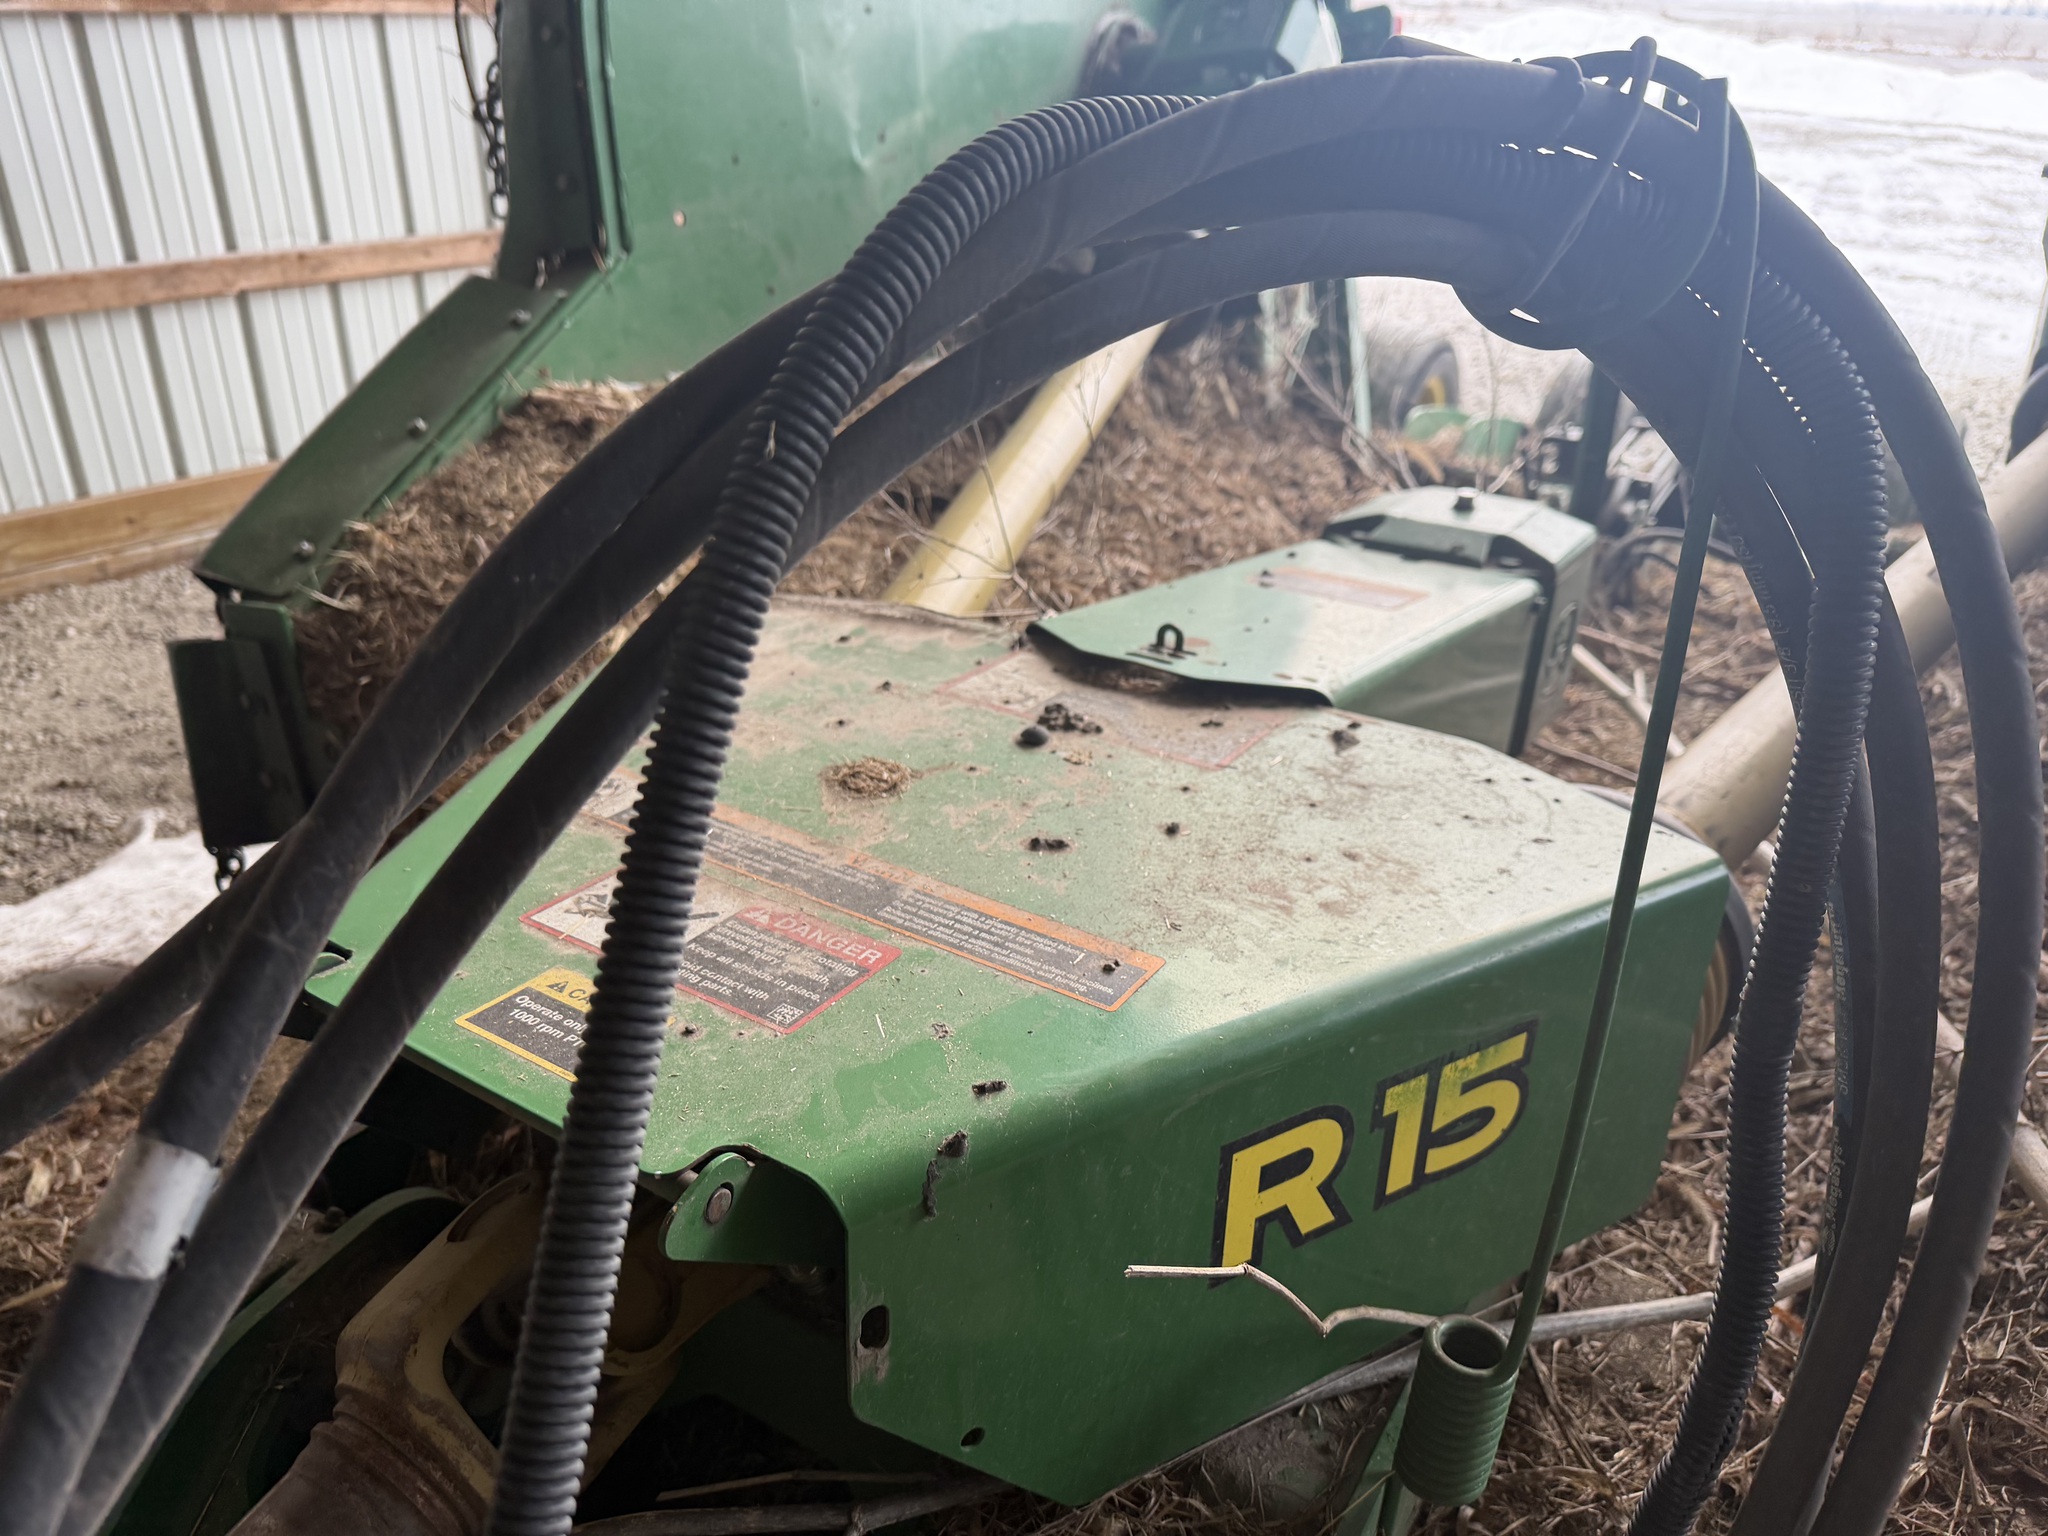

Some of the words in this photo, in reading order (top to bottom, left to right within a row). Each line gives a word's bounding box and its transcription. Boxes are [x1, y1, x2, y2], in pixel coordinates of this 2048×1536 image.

[707, 933, 748, 950] serious
[748, 949, 782, 964] injury
[717, 927, 764, 948] driveline
[765, 946, 786, 956] can
[727, 920, 800, 952] Entanglement
[814, 956, 860, 976] rotating
[775, 917, 882, 964] DANGER
[686, 943, 718, 958] Keep
[717, 955, 734, 964] all
[732, 962, 774, 982] shields
[774, 978, 788, 986] in
[786, 985, 824, 1002] place.
[700, 969, 746, 988] contact
[743, 986, 772, 1000] with
[701, 980, 736, 996] parts.
[516, 995, 564, 1020] Operate
[510, 1008, 538, 1024] 1000
[538, 1022, 564, 1038] rpm
[565, 1033, 586, 1048] PT
